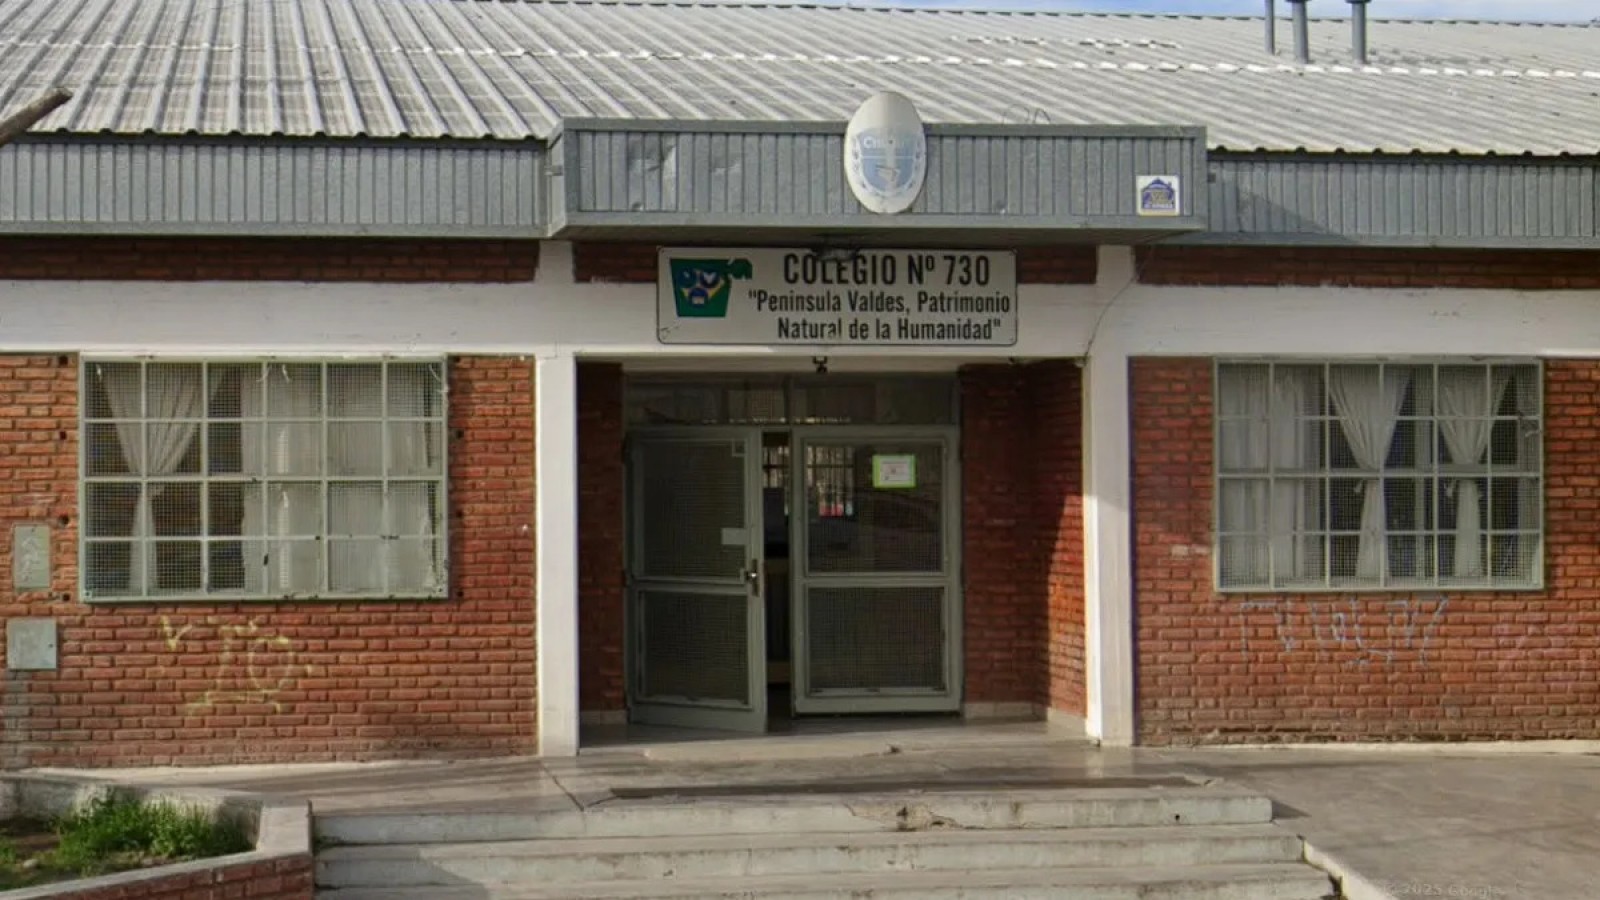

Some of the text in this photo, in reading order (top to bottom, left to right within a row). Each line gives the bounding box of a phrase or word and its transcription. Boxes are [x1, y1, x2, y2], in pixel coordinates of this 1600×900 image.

[784, 253, 897, 285] COLEGIO
[943, 255, 990, 286] 730
[748, 289, 1010, 315] "Peninsula Valdes, Patrimonio
[777, 317, 1001, 341] Natural de la Humanidad"
